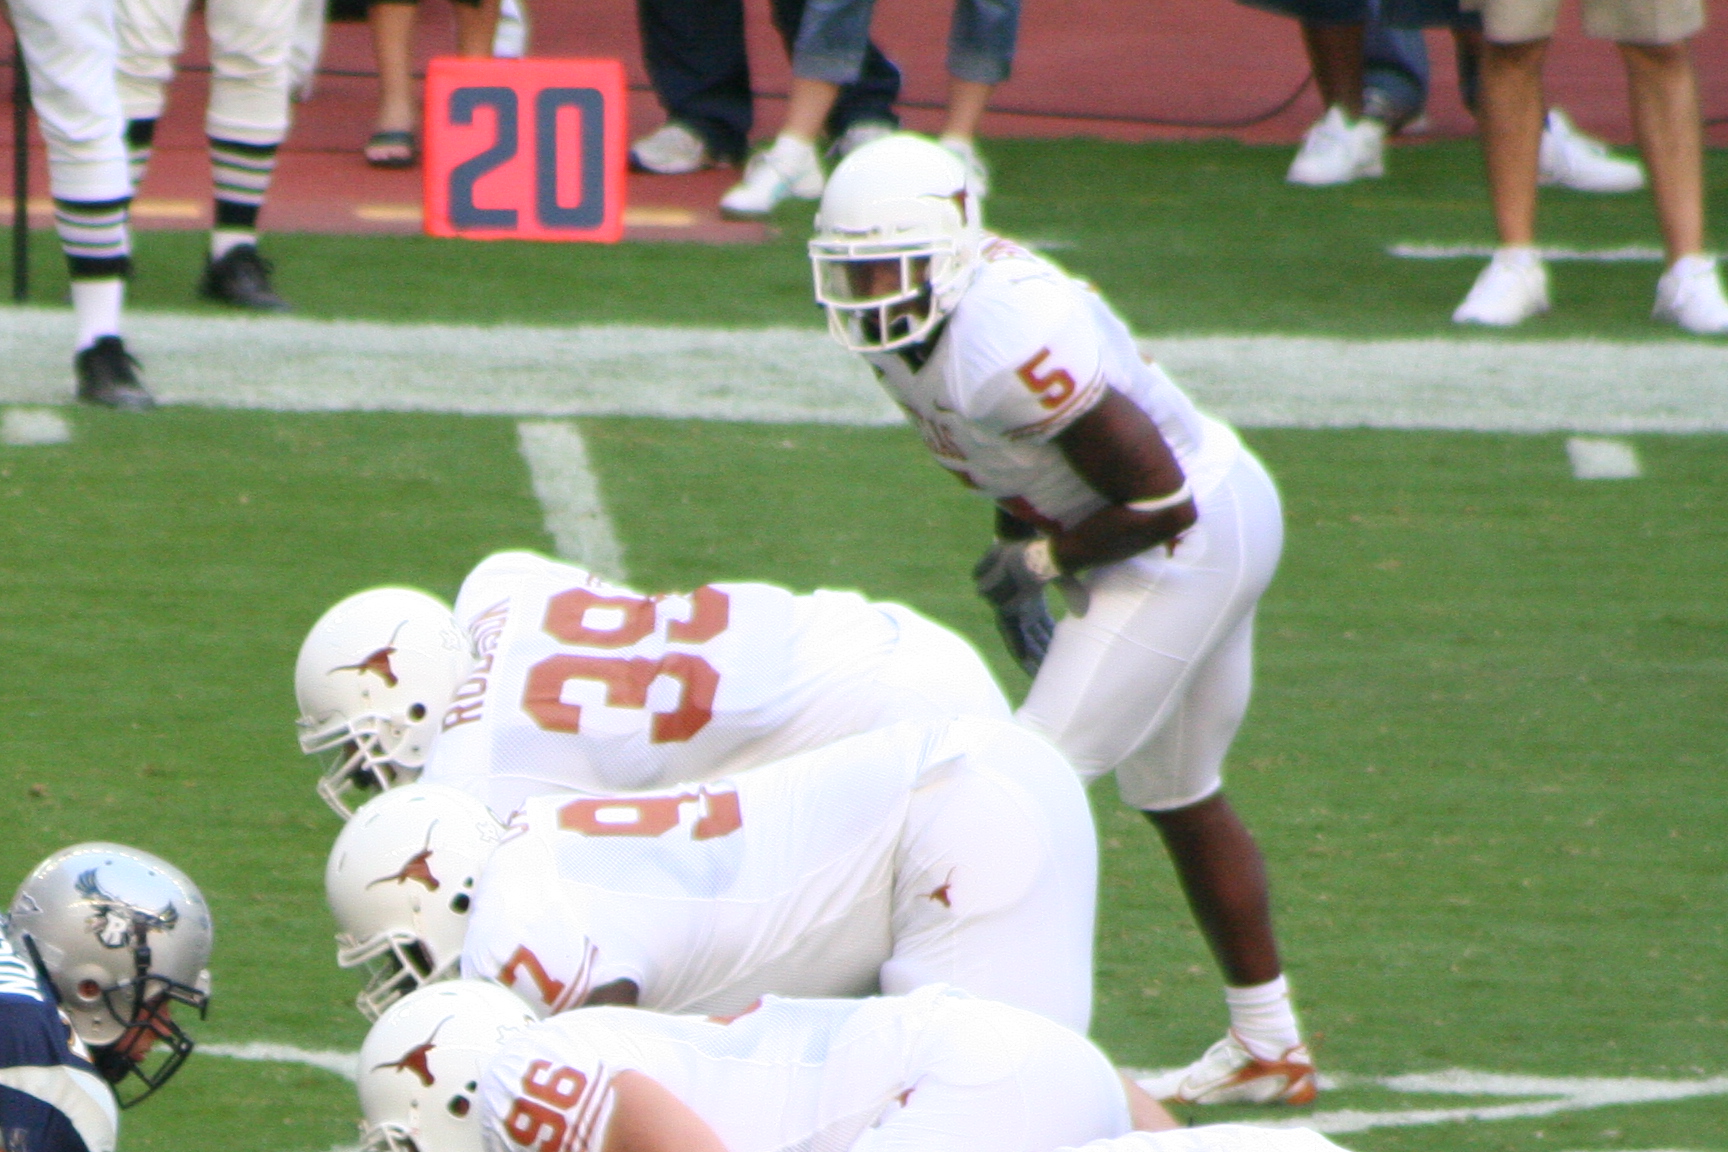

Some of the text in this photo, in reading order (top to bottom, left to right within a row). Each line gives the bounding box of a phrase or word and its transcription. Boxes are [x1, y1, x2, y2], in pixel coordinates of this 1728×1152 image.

[448, 87, 605, 231] 20
[1016, 346, 1075, 409] 5
[520, 584, 730, 745] 39
